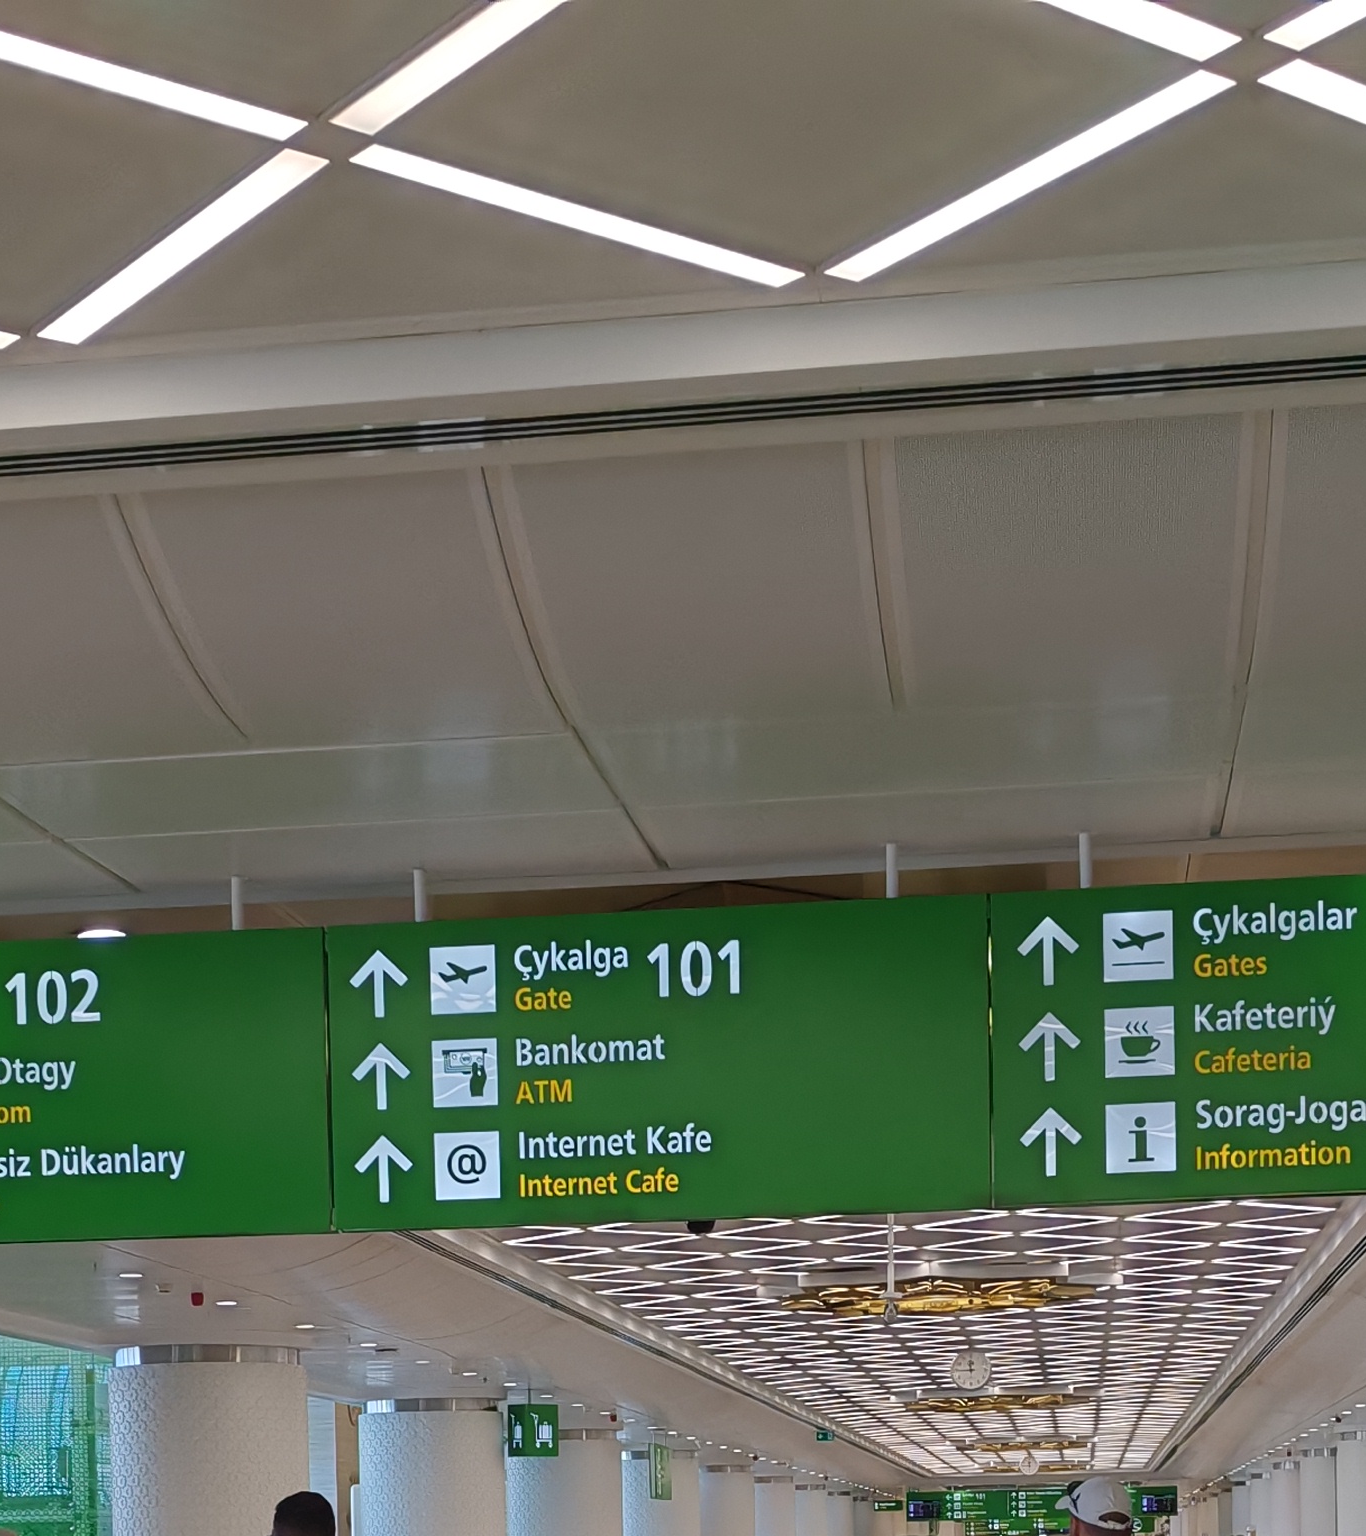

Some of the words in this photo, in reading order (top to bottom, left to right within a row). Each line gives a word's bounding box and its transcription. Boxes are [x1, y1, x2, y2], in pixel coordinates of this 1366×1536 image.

[1194, 901, 1357, 944] Çykalgalar
[515, 940, 628, 980] Çykalga
[647, 940, 739, 997] 101
[1194, 954, 1266, 977] Gates
[6, 969, 100, 1024] 102
[515, 988, 571, 1010] Gate
[1195, 997, 1335, 1034] Kafeteriý
[516, 1034, 665, 1066] Bankomat
[1195, 1046, 1310, 1073] Cafeteria
[516, 1079, 572, 1104] ATM
[519, 1130, 636, 1159] Internet
[647, 1123, 711, 1153] Kafe
[1197, 1141, 1350, 1169] Information
[41, 1144, 184, 1179] Dükanlary
[520, 1172, 617, 1197] Internet
[626, 1167, 678, 1193] Cafe
